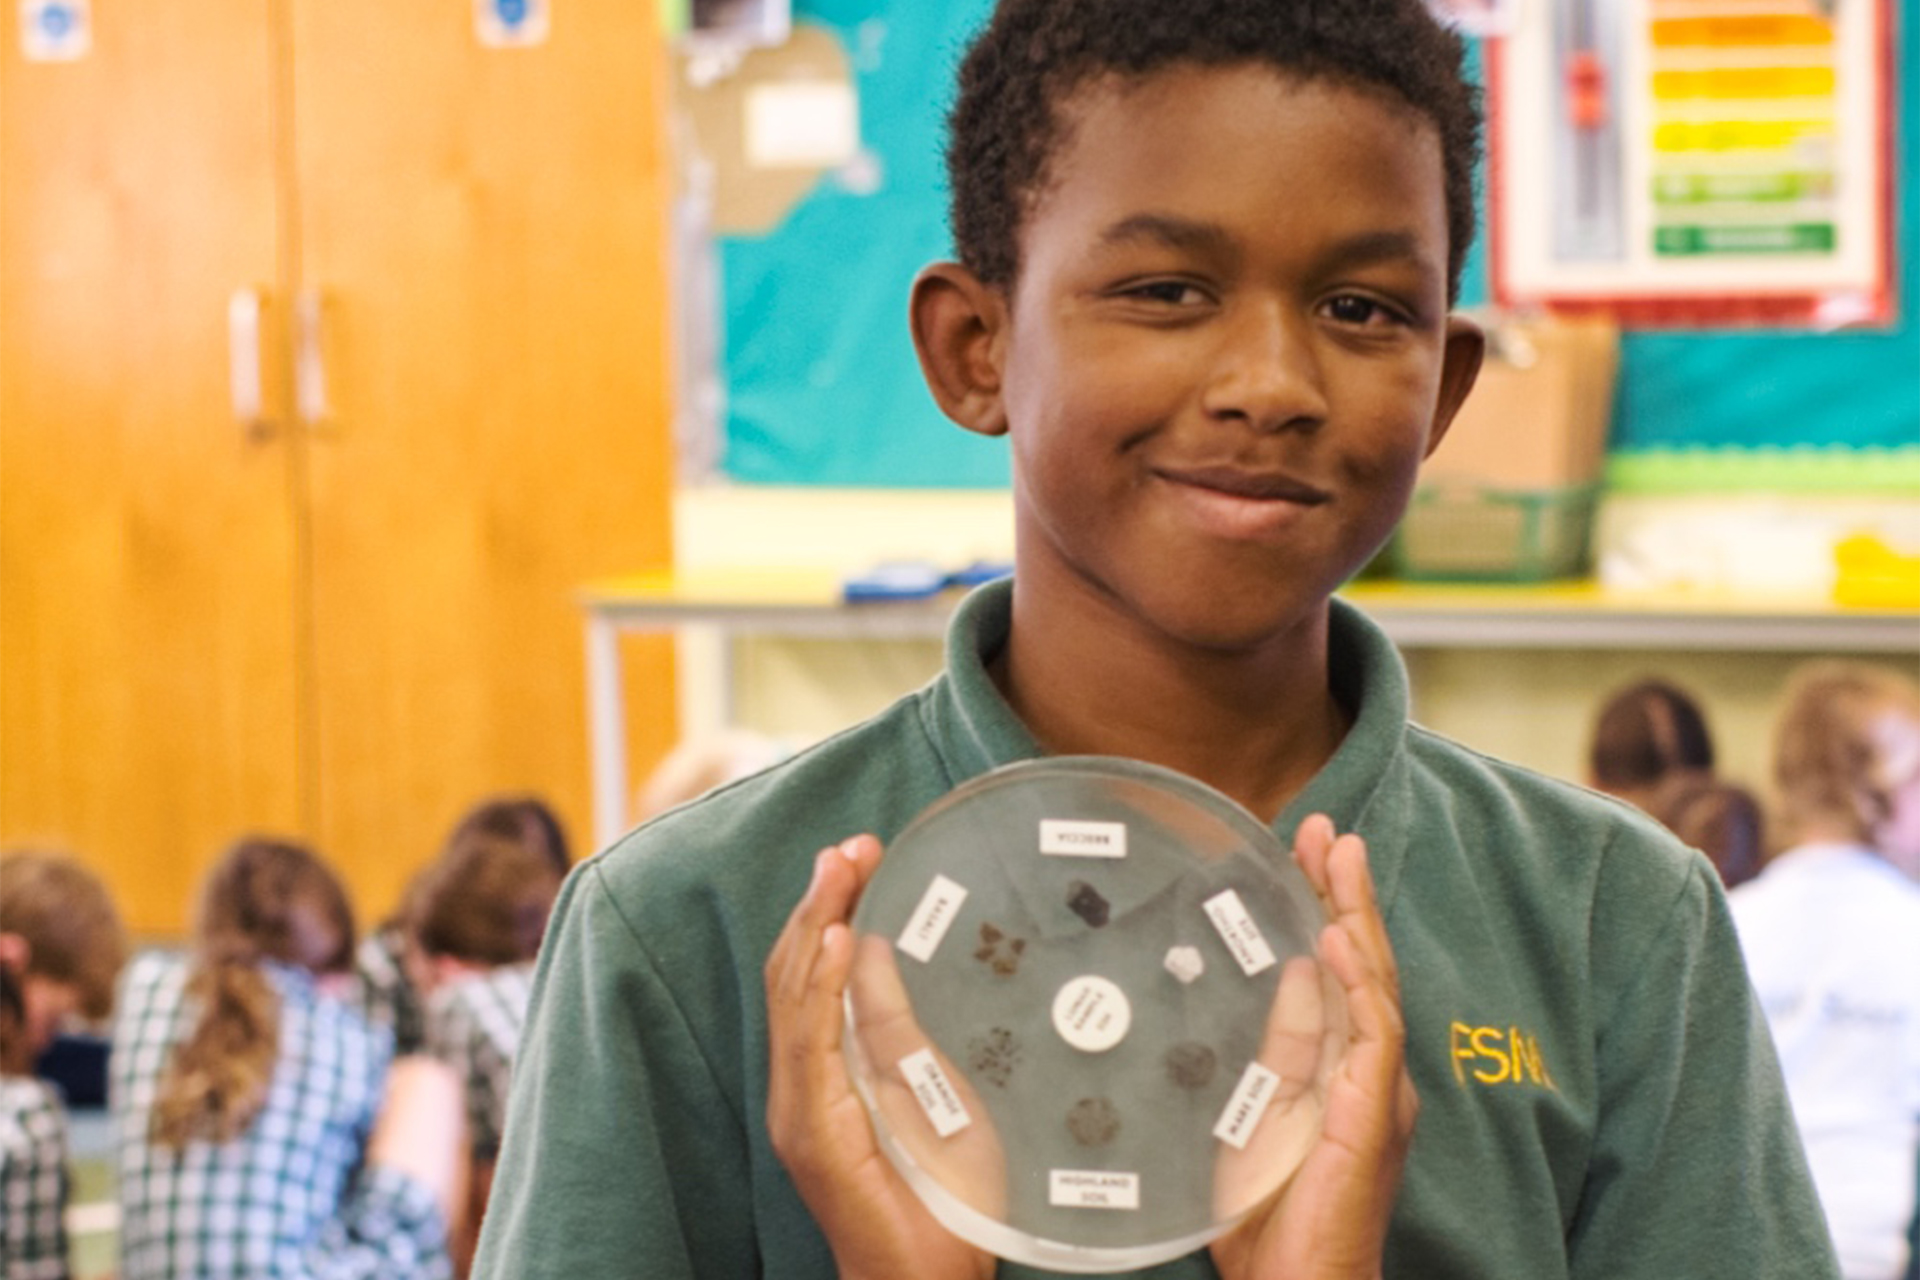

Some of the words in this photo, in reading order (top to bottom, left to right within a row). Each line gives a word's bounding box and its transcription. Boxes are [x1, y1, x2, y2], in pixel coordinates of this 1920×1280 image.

[923, 1062, 960, 1116] ORANGE
[1229, 1101, 1252, 1136] MARE
[1058, 1176, 1131, 1189] HIGHLAND
[1081, 1191, 1109, 1205] SOIL
